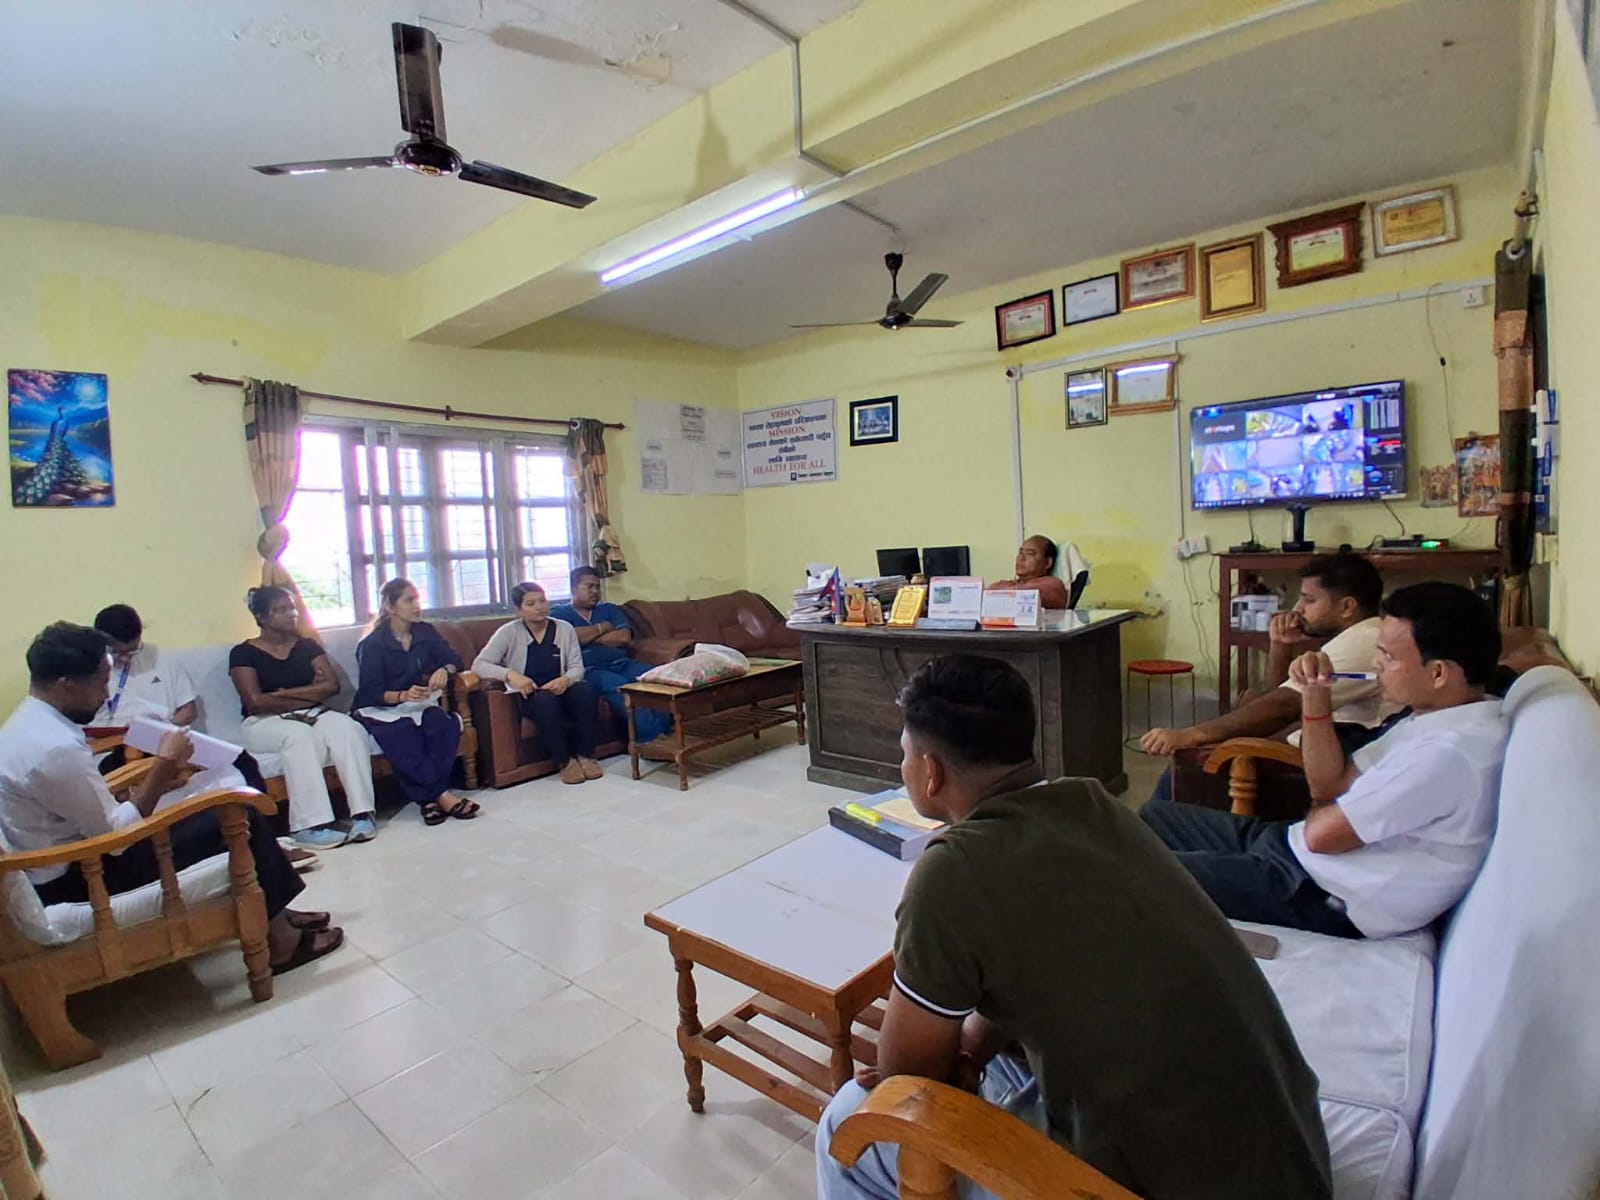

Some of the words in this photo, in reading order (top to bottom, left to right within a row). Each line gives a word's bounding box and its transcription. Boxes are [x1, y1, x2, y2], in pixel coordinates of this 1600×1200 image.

[771, 408, 801, 419] VISION
[768, 426, 806, 438] MISSION
[753, 463, 787, 475] HEALTH
[789, 461, 807, 473] FOR
[809, 459, 826, 470] ALL
